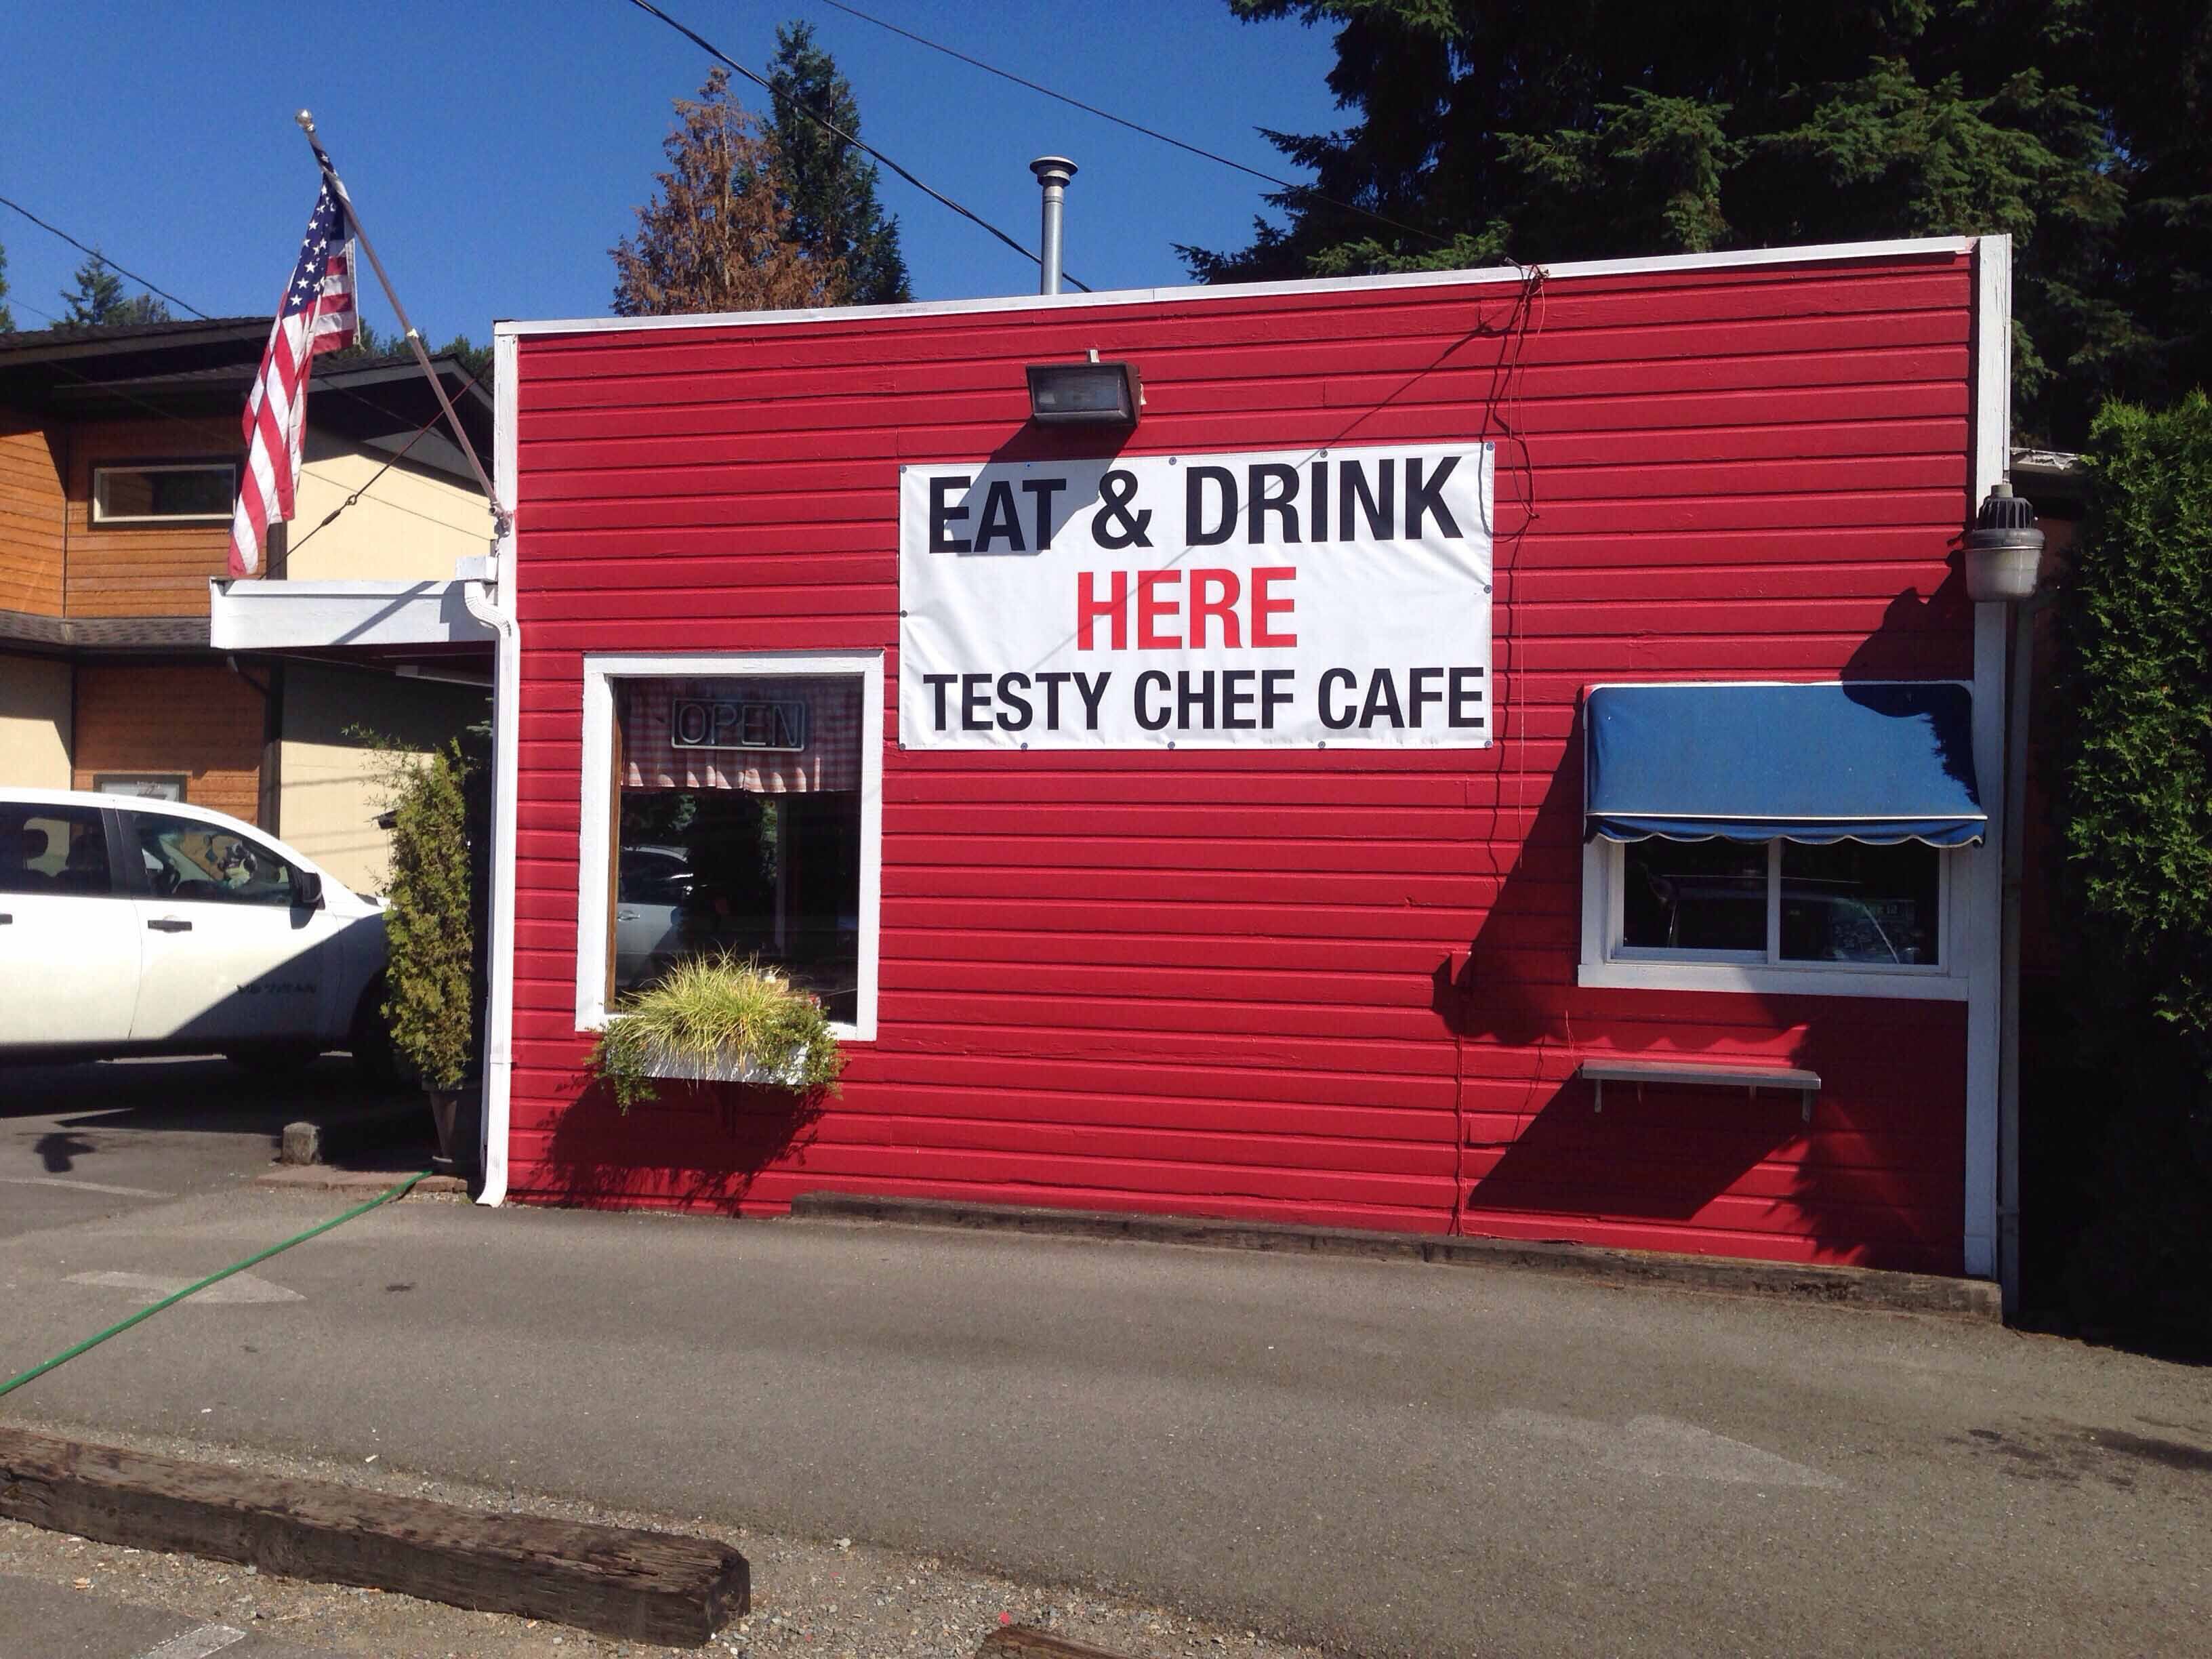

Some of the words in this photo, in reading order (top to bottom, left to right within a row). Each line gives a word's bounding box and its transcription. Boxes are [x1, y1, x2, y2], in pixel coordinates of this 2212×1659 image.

[928, 476, 1067, 554] EAT
[1090, 469, 1154, 550] &
[1185, 455, 1464, 546] DRINK
[1078, 566, 1298, 651] HERE
[678, 703, 799, 746] OPEN
[922, 671, 1113, 731] TESTY
[1133, 670, 1295, 731] CHEF
[1317, 667, 1485, 730] CAFE
